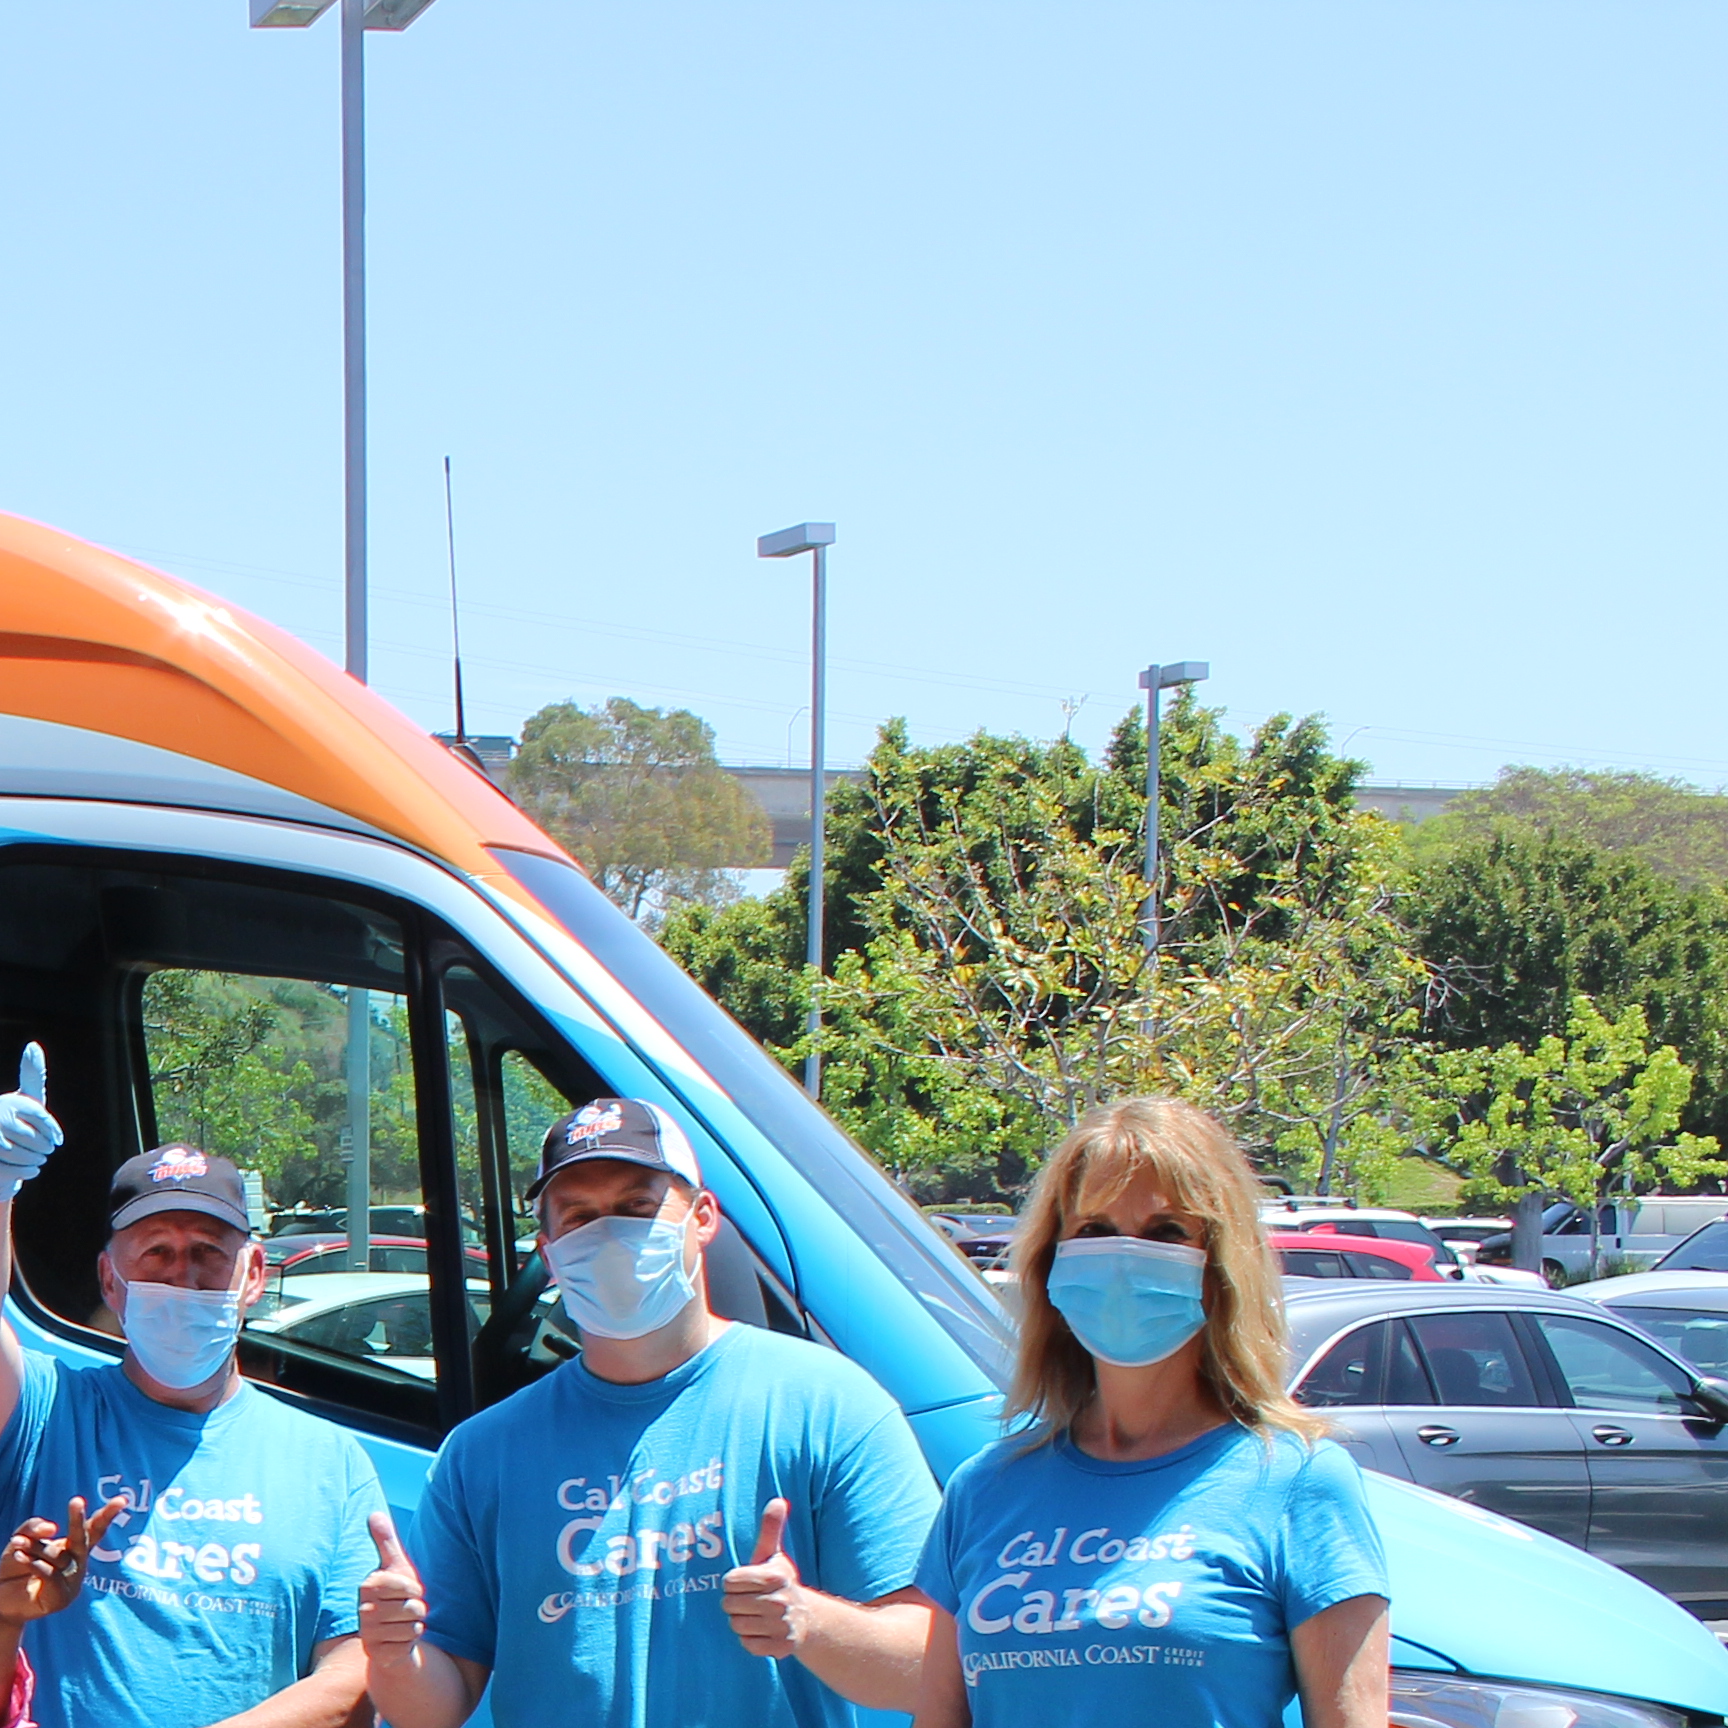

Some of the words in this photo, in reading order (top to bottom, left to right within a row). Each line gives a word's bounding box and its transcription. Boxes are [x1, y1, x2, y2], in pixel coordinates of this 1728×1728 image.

[97, 1474, 150, 1512] Cal
[156, 1489, 263, 1524] Coast
[557, 1476, 625, 1510] Cal
[631, 1457, 724, 1504] Coast
[86, 1512, 262, 1585] Cares
[556, 1510, 724, 1576] Cares
[997, 1528, 1067, 1568] Cal
[1069, 1525, 1197, 1564] Coast
[84, 1573, 179, 1607] ALIFORNIA
[184, 1592, 247, 1613] COAST
[664, 1574, 722, 1597] COAST
[967, 1572, 1182, 1635] Cares
[969, 1649, 1081, 1671] CALIFORNIA
[1085, 1644, 1160, 1665] COAST
[1164, 1647, 1205, 1658] CREDIT
[1164, 1657, 1204, 1667] UNION
